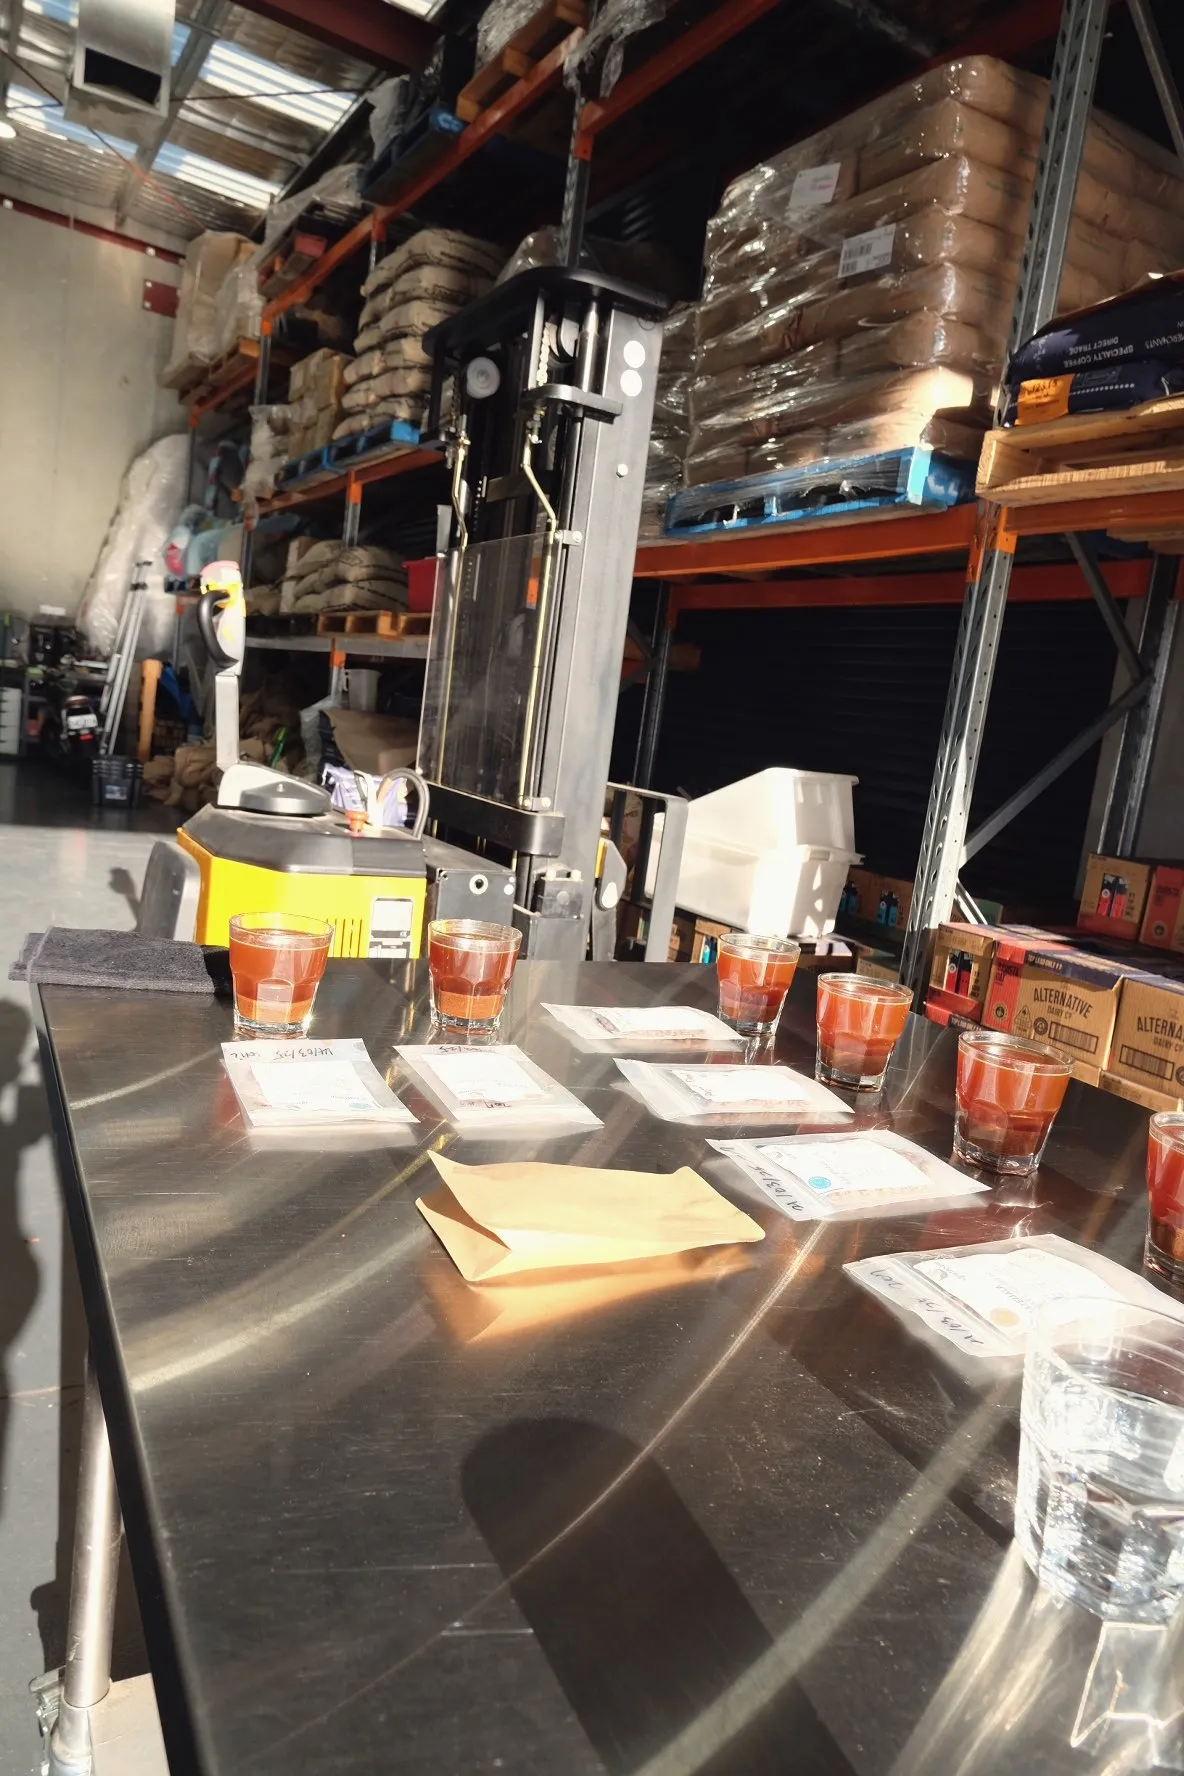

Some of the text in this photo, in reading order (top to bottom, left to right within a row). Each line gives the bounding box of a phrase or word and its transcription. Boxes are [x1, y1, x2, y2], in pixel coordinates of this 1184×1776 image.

[1063, 345, 1134, 368] SPECIALTY COFFEE
[1068, 336, 1119, 355] DIRECT TRADE
[1033, 987, 1093, 1019] ALTERNATIVE
[1047, 1005, 1064, 1017] DAIRY
[1137, 1015, 1184, 1042] ALTERNA
